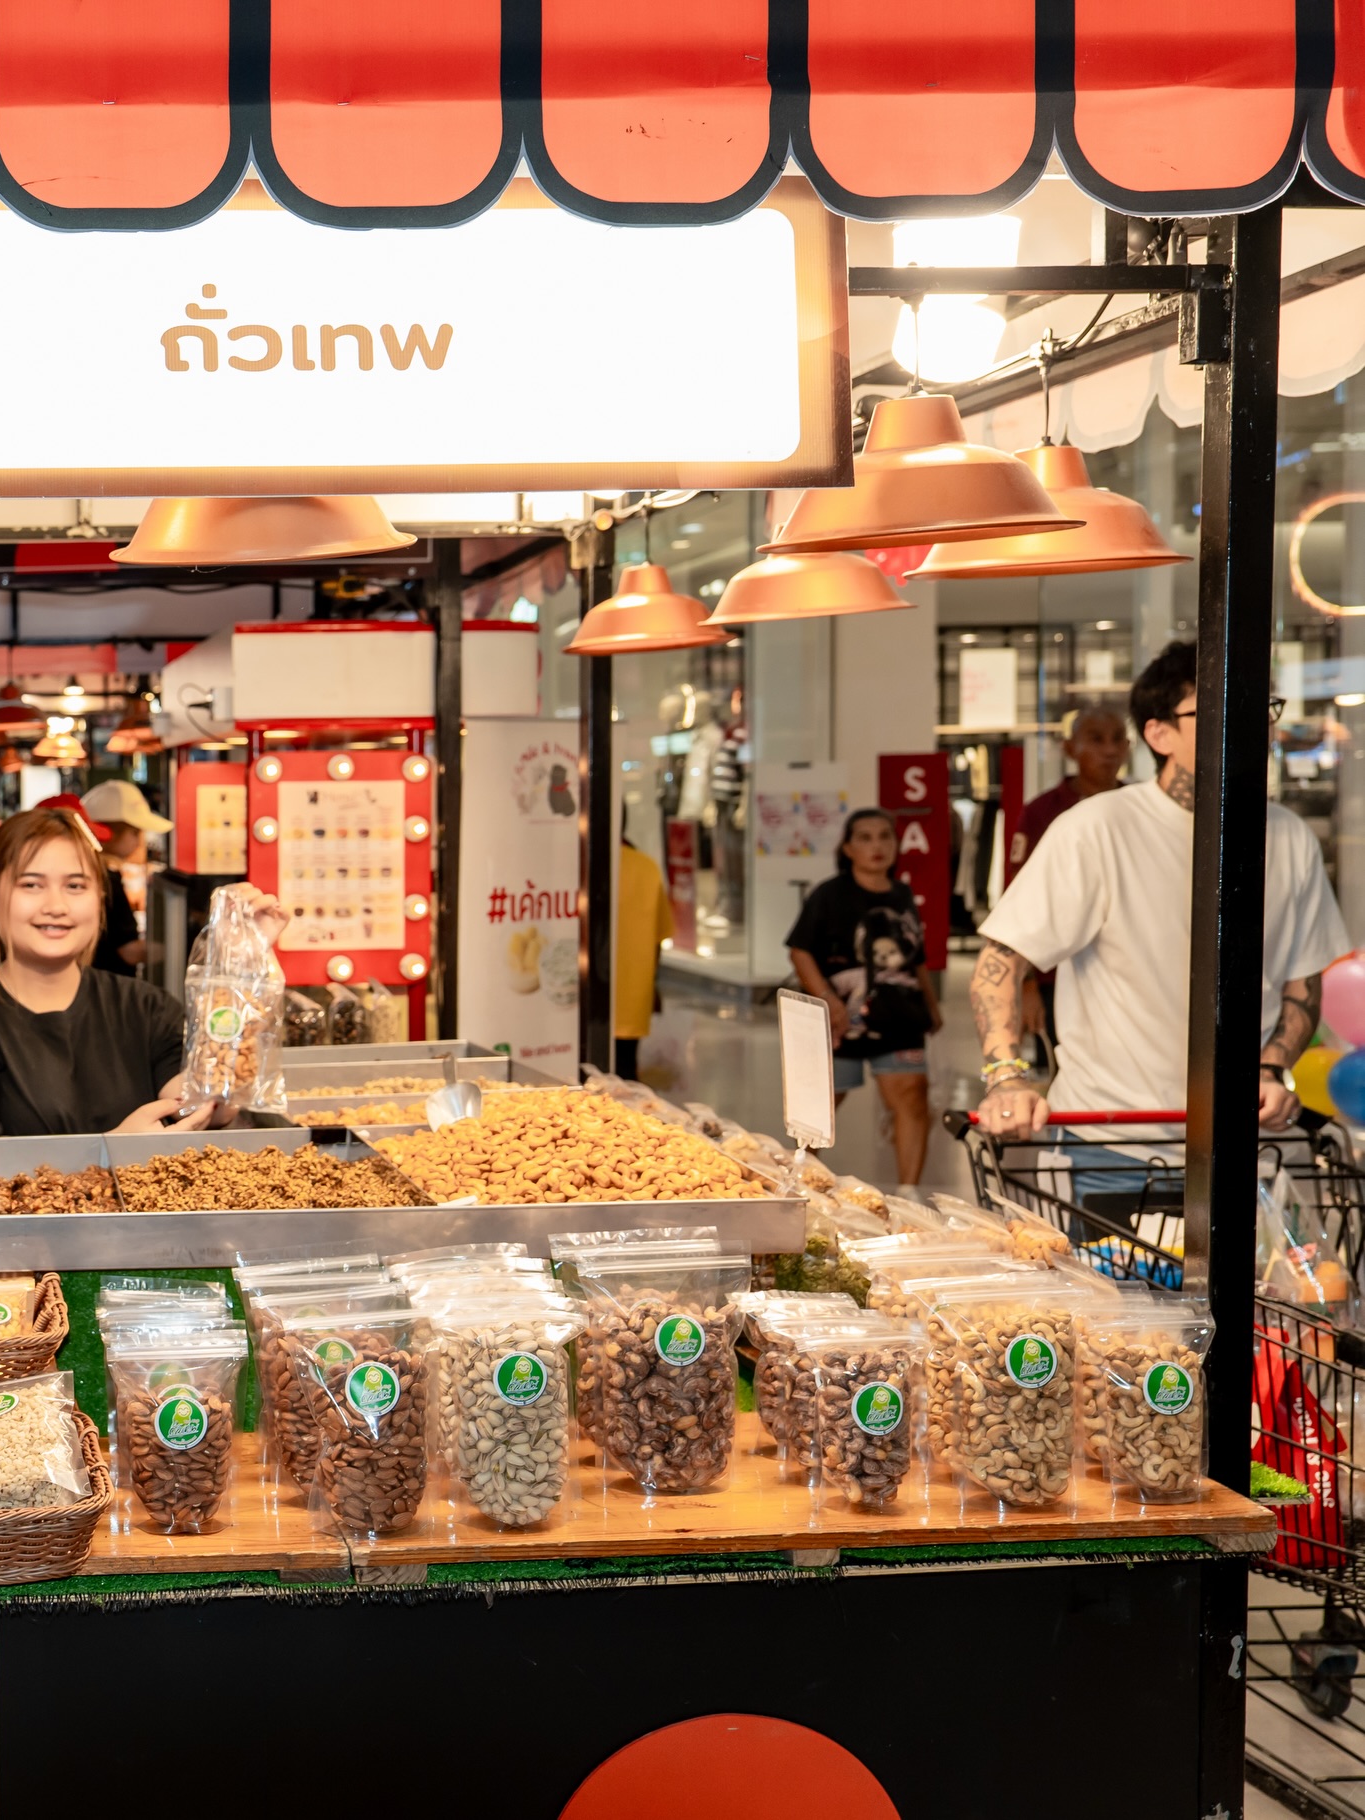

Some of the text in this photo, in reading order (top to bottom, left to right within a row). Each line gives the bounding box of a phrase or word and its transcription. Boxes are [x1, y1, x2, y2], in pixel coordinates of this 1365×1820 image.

[160, 283, 454, 372] ถั่วเทพ
[487, 880, 579, 923] #เค้กเน
